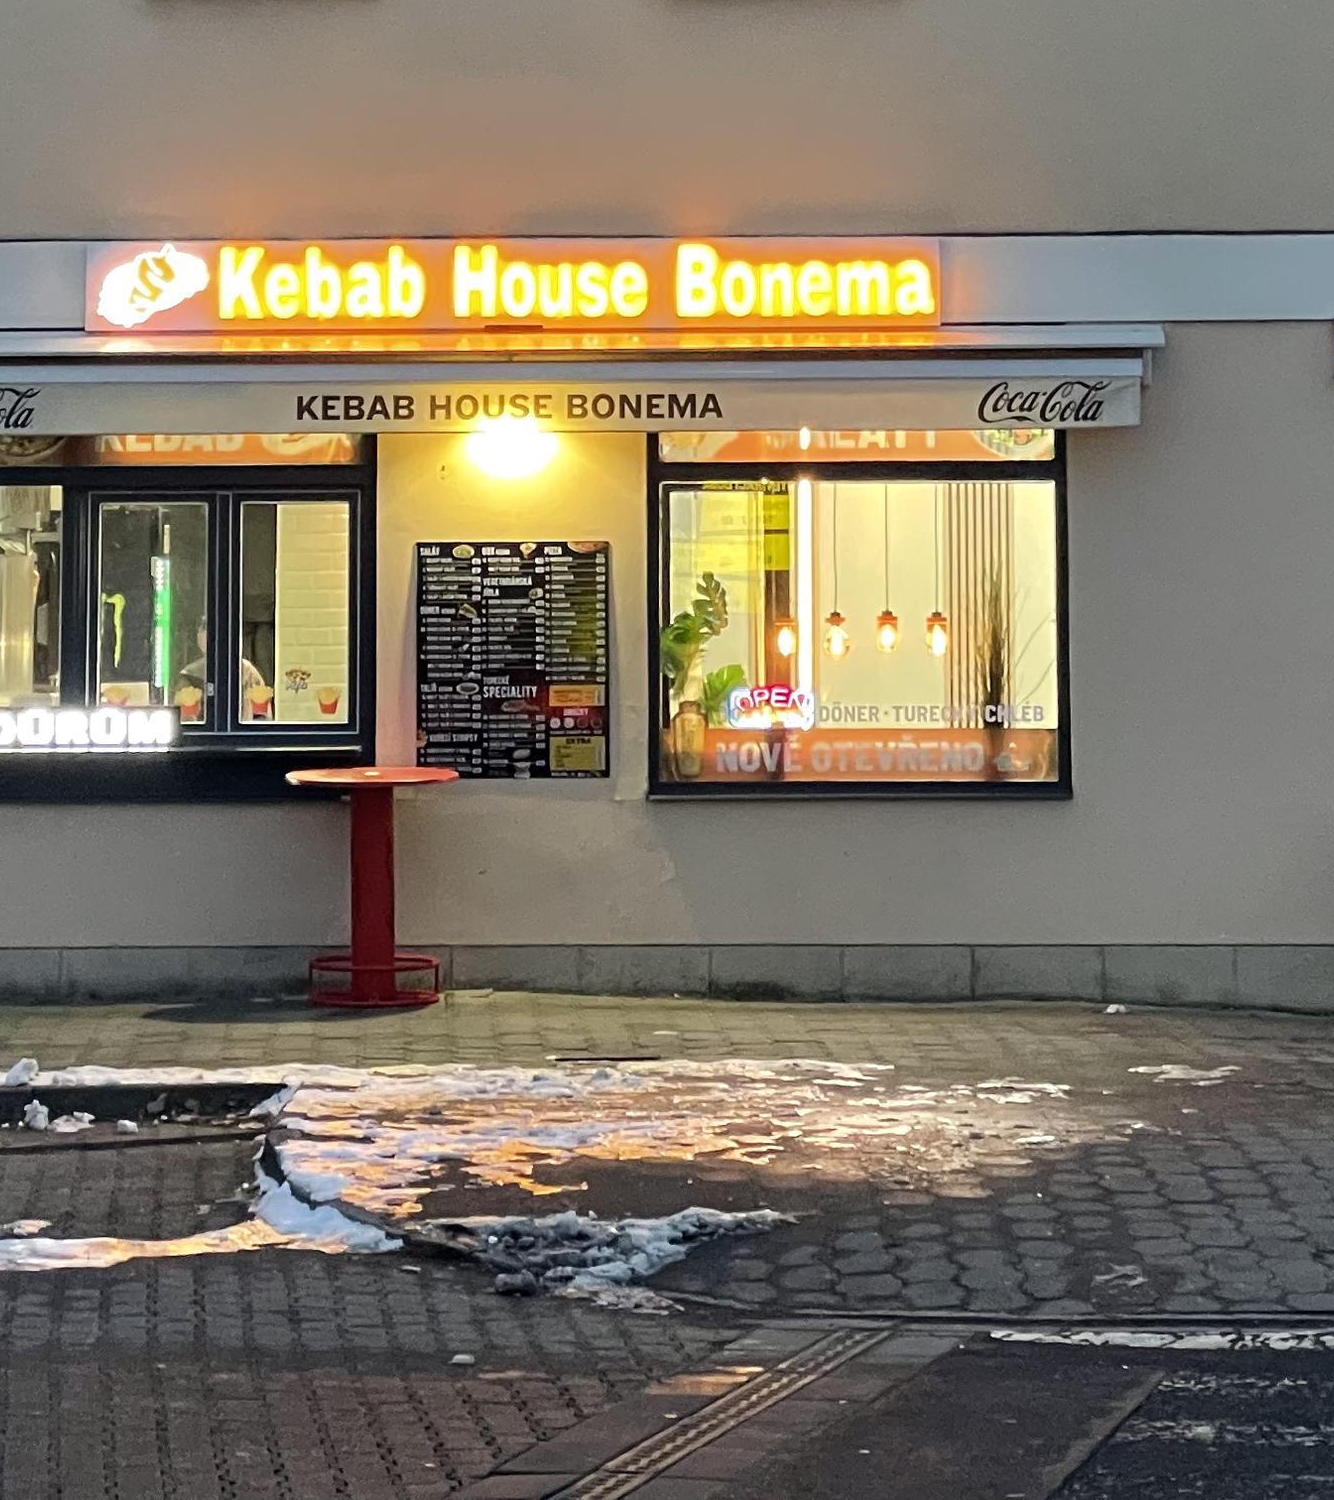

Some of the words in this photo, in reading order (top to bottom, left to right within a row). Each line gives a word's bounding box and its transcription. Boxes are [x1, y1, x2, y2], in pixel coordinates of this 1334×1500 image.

[219, 246, 426, 320] Kebab
[453, 243, 649, 319] House
[676, 243, 935, 318] Bonema
[297, 394, 415, 422] KEBAB
[430, 393, 553, 421] HOUSE
[568, 392, 724, 420] BONEMA
[978, 381, 1111, 423] Coca-Cola
[483, 686, 538, 699] SPECIALITY
[734, 687, 811, 715] OPEN
[819, 701, 879, 722] DÖNER
[984, 701, 1045, 723] CHLÉB
